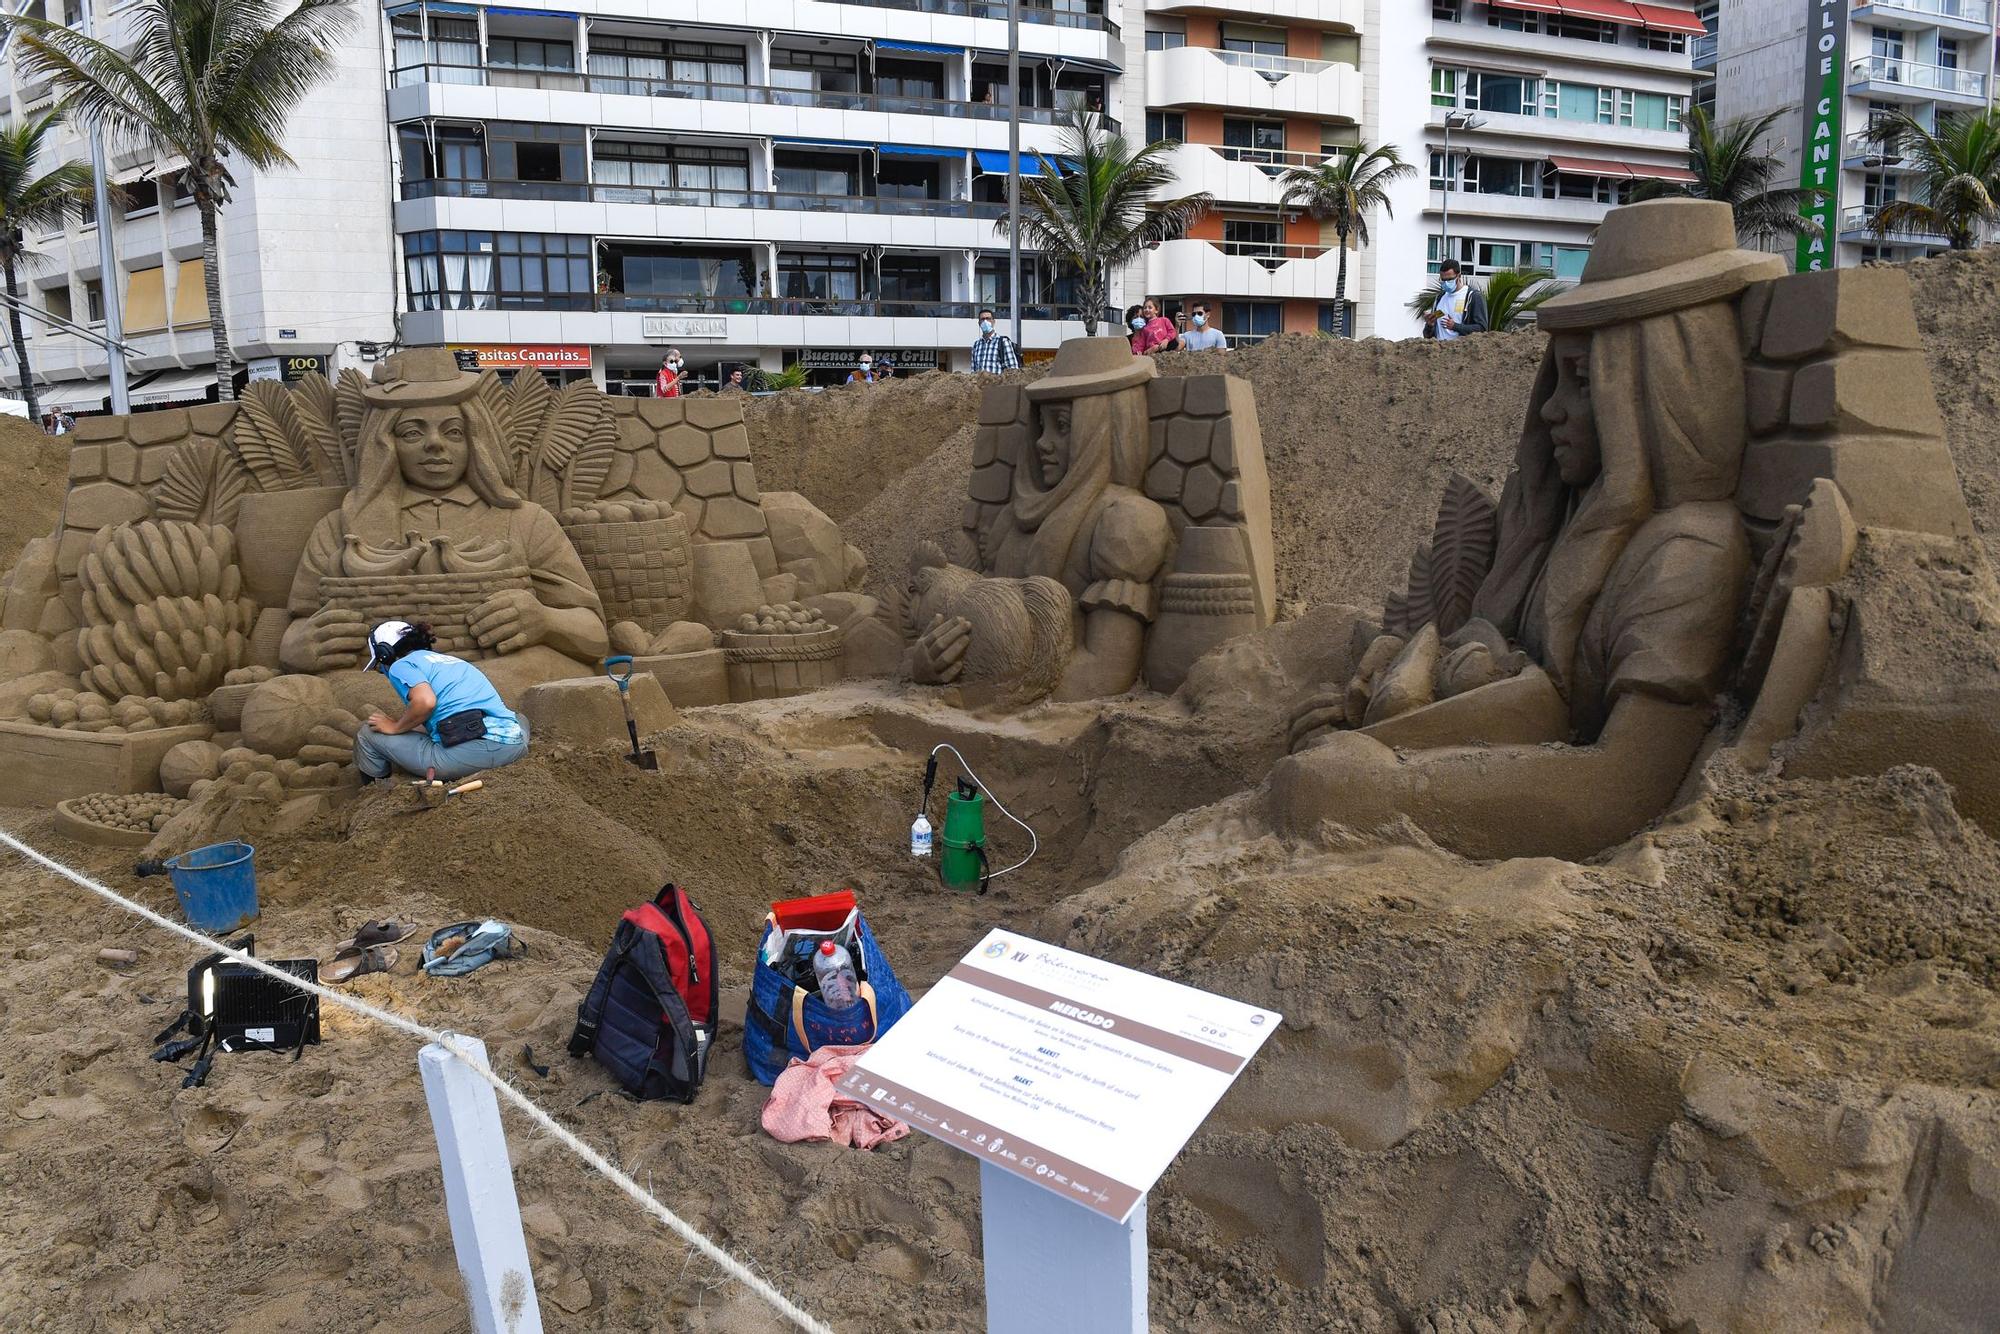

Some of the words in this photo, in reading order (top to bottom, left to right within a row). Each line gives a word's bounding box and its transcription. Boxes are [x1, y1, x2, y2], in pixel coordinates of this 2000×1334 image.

[471, 348, 517, 361] asitas
[802, 349, 856, 362] Buenos
[859, 349, 898, 362] ires
[901, 349, 935, 362] Grill
[287, 357, 318, 371] 100
[1010, 951, 1029, 962] XV
[1050, 1001, 1114, 1028] MERCADO
